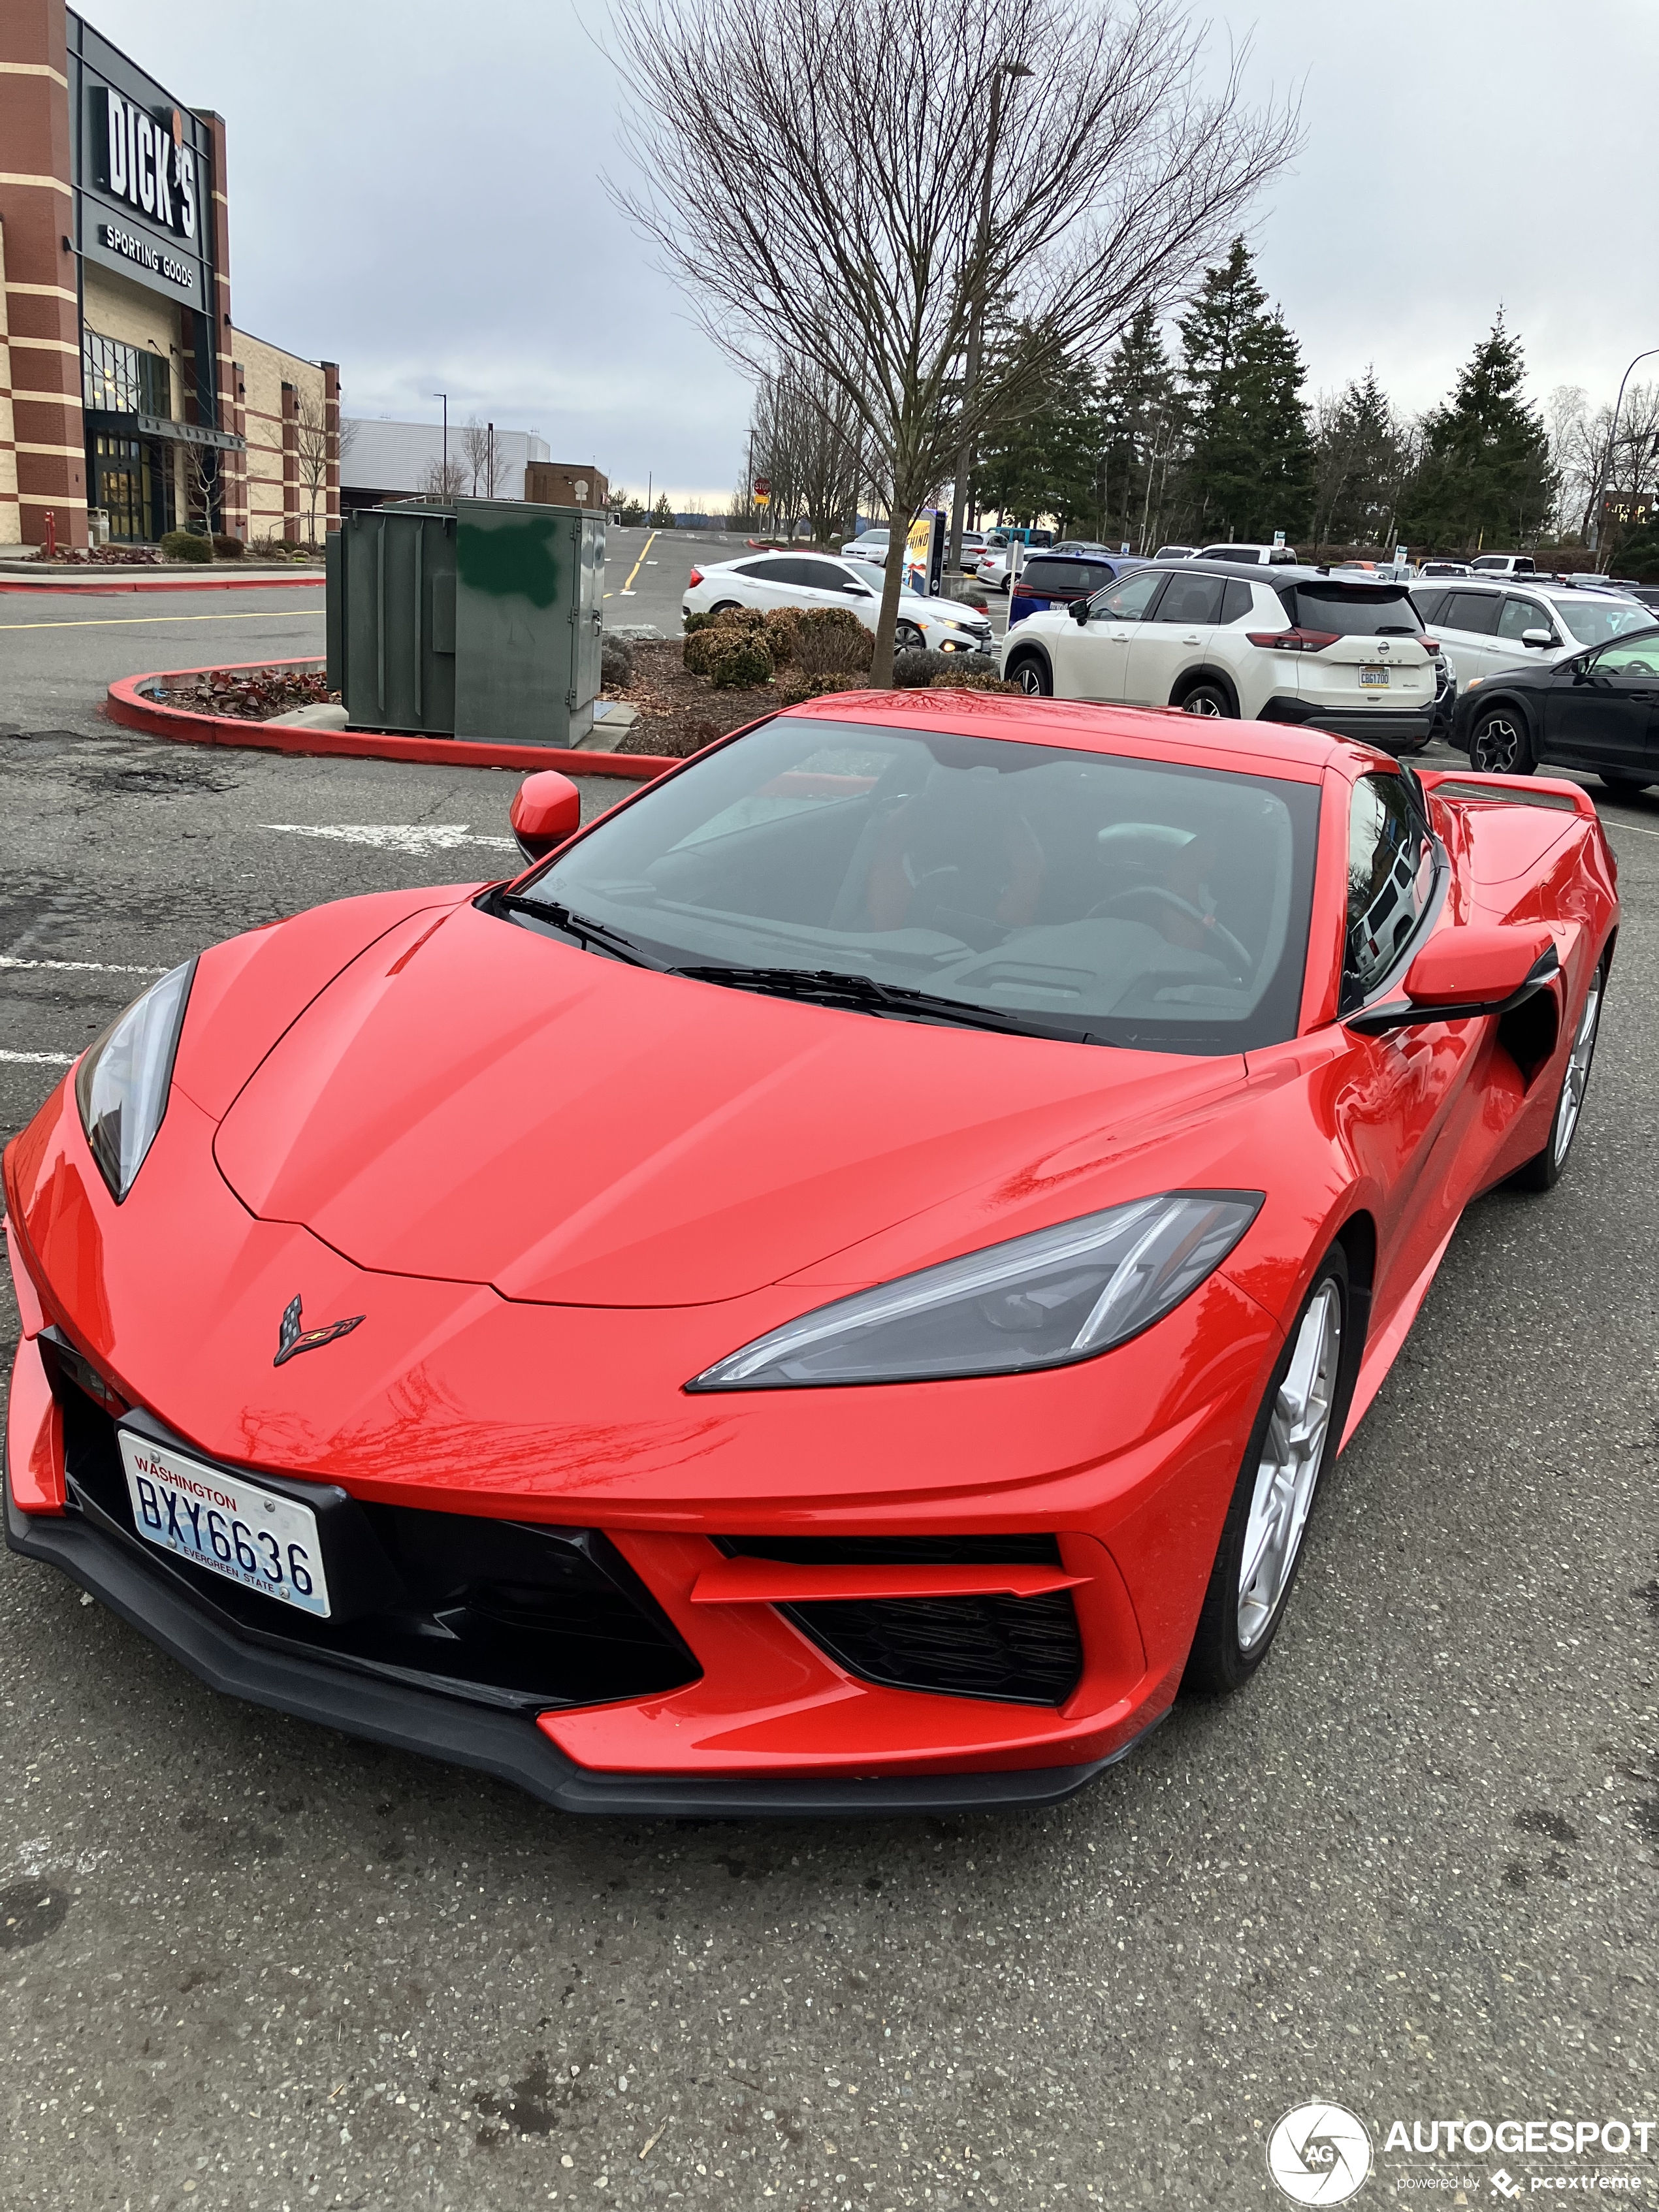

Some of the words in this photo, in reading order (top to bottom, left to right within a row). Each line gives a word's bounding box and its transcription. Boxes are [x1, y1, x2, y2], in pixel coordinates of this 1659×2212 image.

[108, 88, 195, 239] DICK'S
[106, 224, 159, 270] SPORTING
[163, 255, 193, 289] GOODS
[755, 482, 771, 490] STOP
[134, 1455, 237, 1513] WASHINGTON
[135, 1475, 314, 1595] BXY6636
[184, 1545, 239, 1578] EVERGREEN
[243, 1573, 275, 1593] STATE
